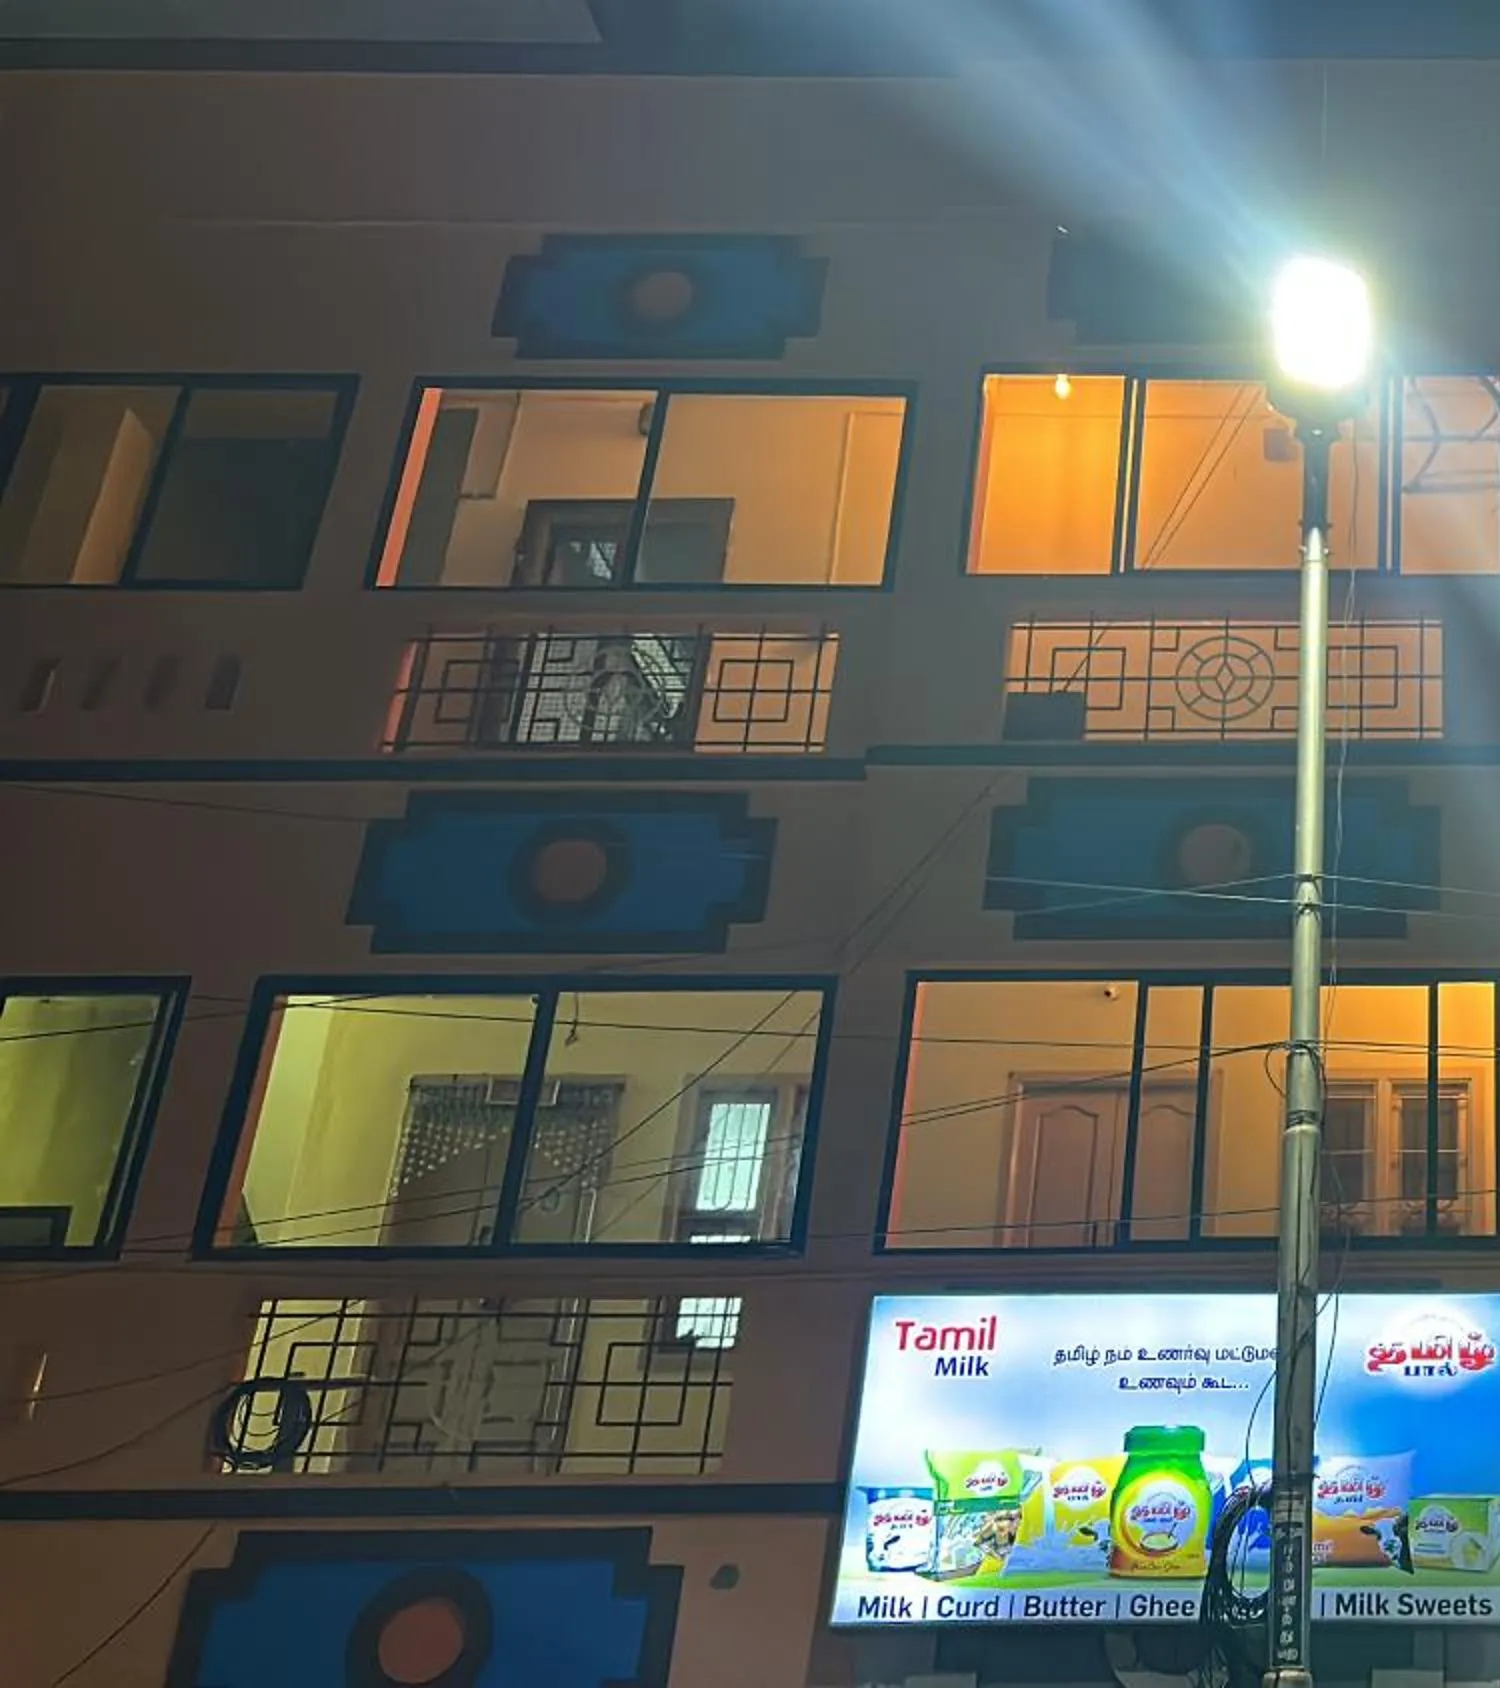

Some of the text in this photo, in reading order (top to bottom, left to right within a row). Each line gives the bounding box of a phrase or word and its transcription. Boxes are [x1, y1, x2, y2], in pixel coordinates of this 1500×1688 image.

[895, 1315, 997, 1351] Tamil
[934, 1355, 989, 1376] Milk
[1053, 1344, 1101, 1366] தமிழ்
[1104, 1345, 1133, 1366] நம்
[1137, 1344, 1211, 1366] உணர்வு
[1404, 1361, 1458, 1377] பால்
[1118, 1373, 1197, 1394] உணவும்
[857, 1593, 1493, 1618] Milk Curd Butter Ghee Milk Sweets
